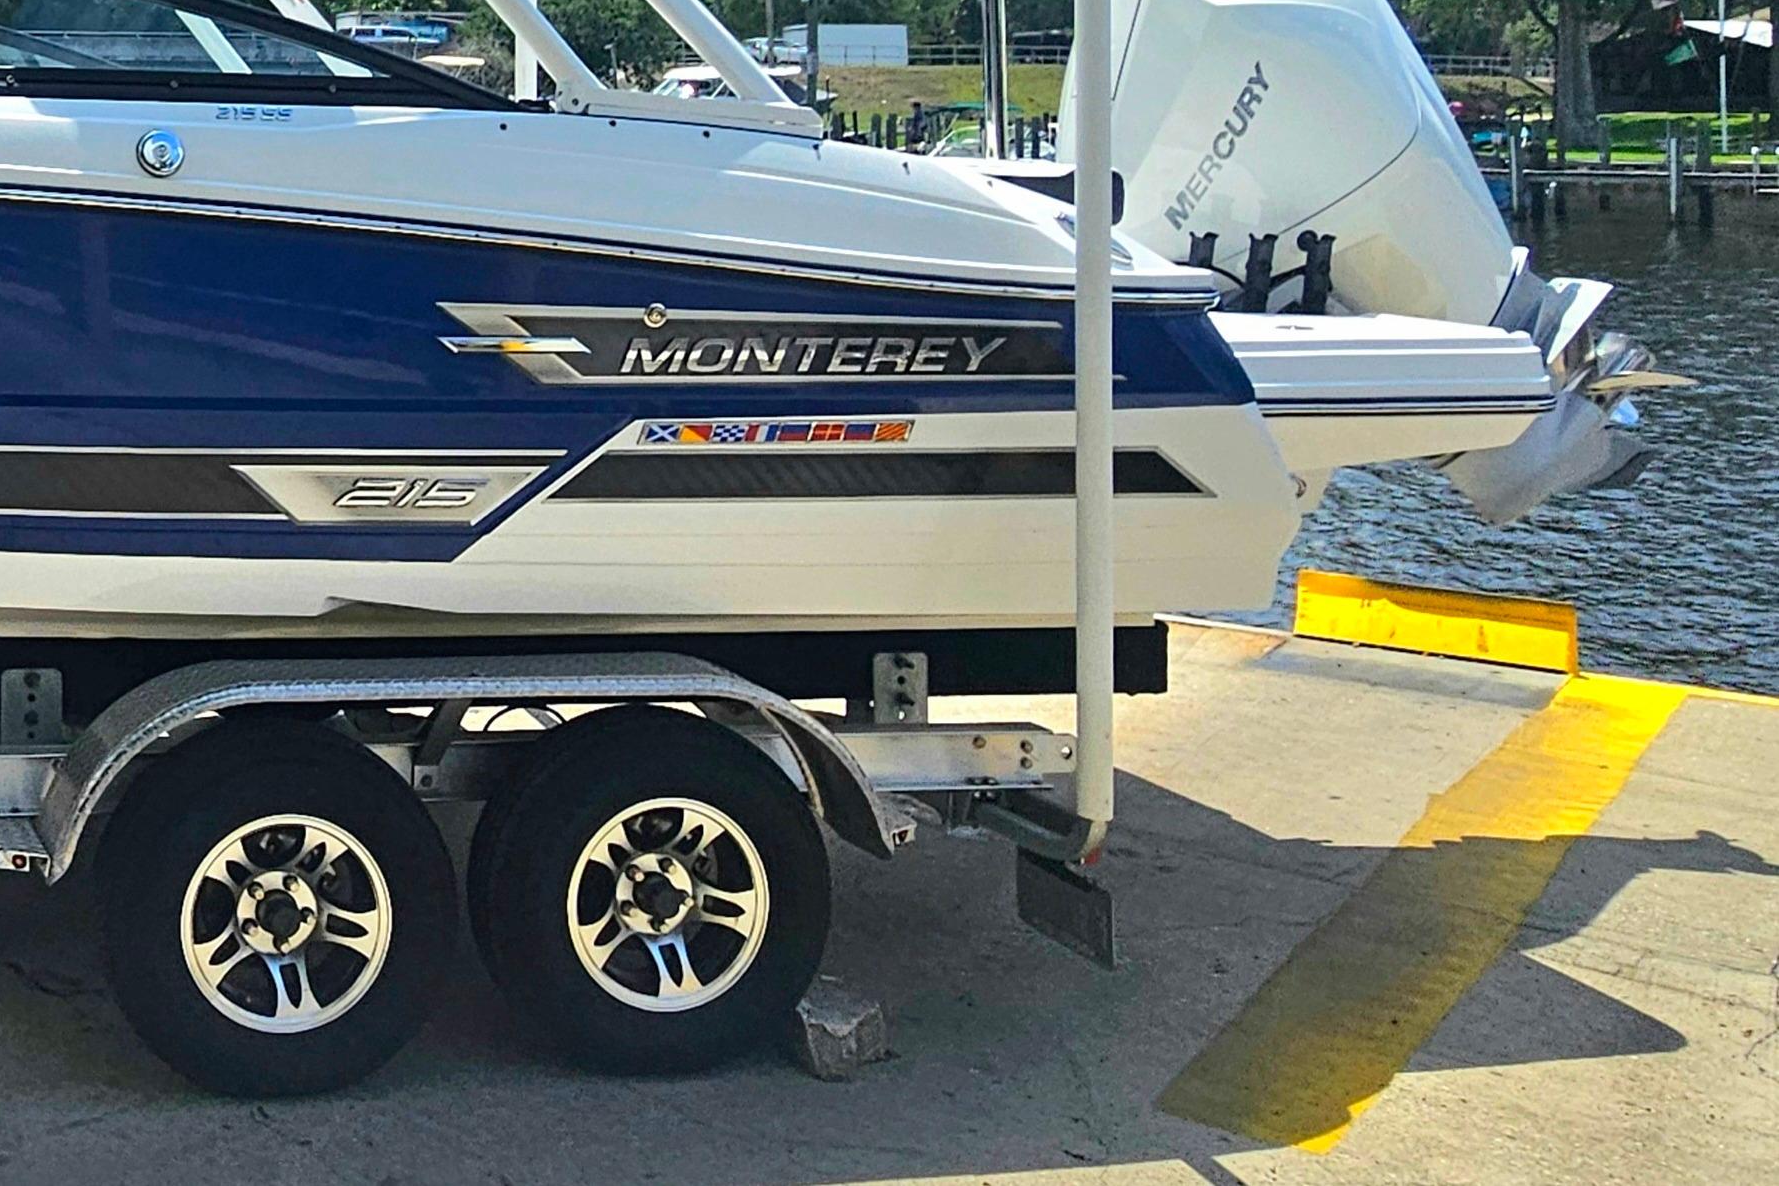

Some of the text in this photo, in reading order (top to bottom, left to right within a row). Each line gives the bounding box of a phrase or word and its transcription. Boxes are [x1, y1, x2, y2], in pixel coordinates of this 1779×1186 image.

[215, 105, 256, 121] 215
[1163, 60, 1270, 232] MERCURY
[620, 336, 1008, 375] MONTEREY
[332, 477, 490, 508] 215
